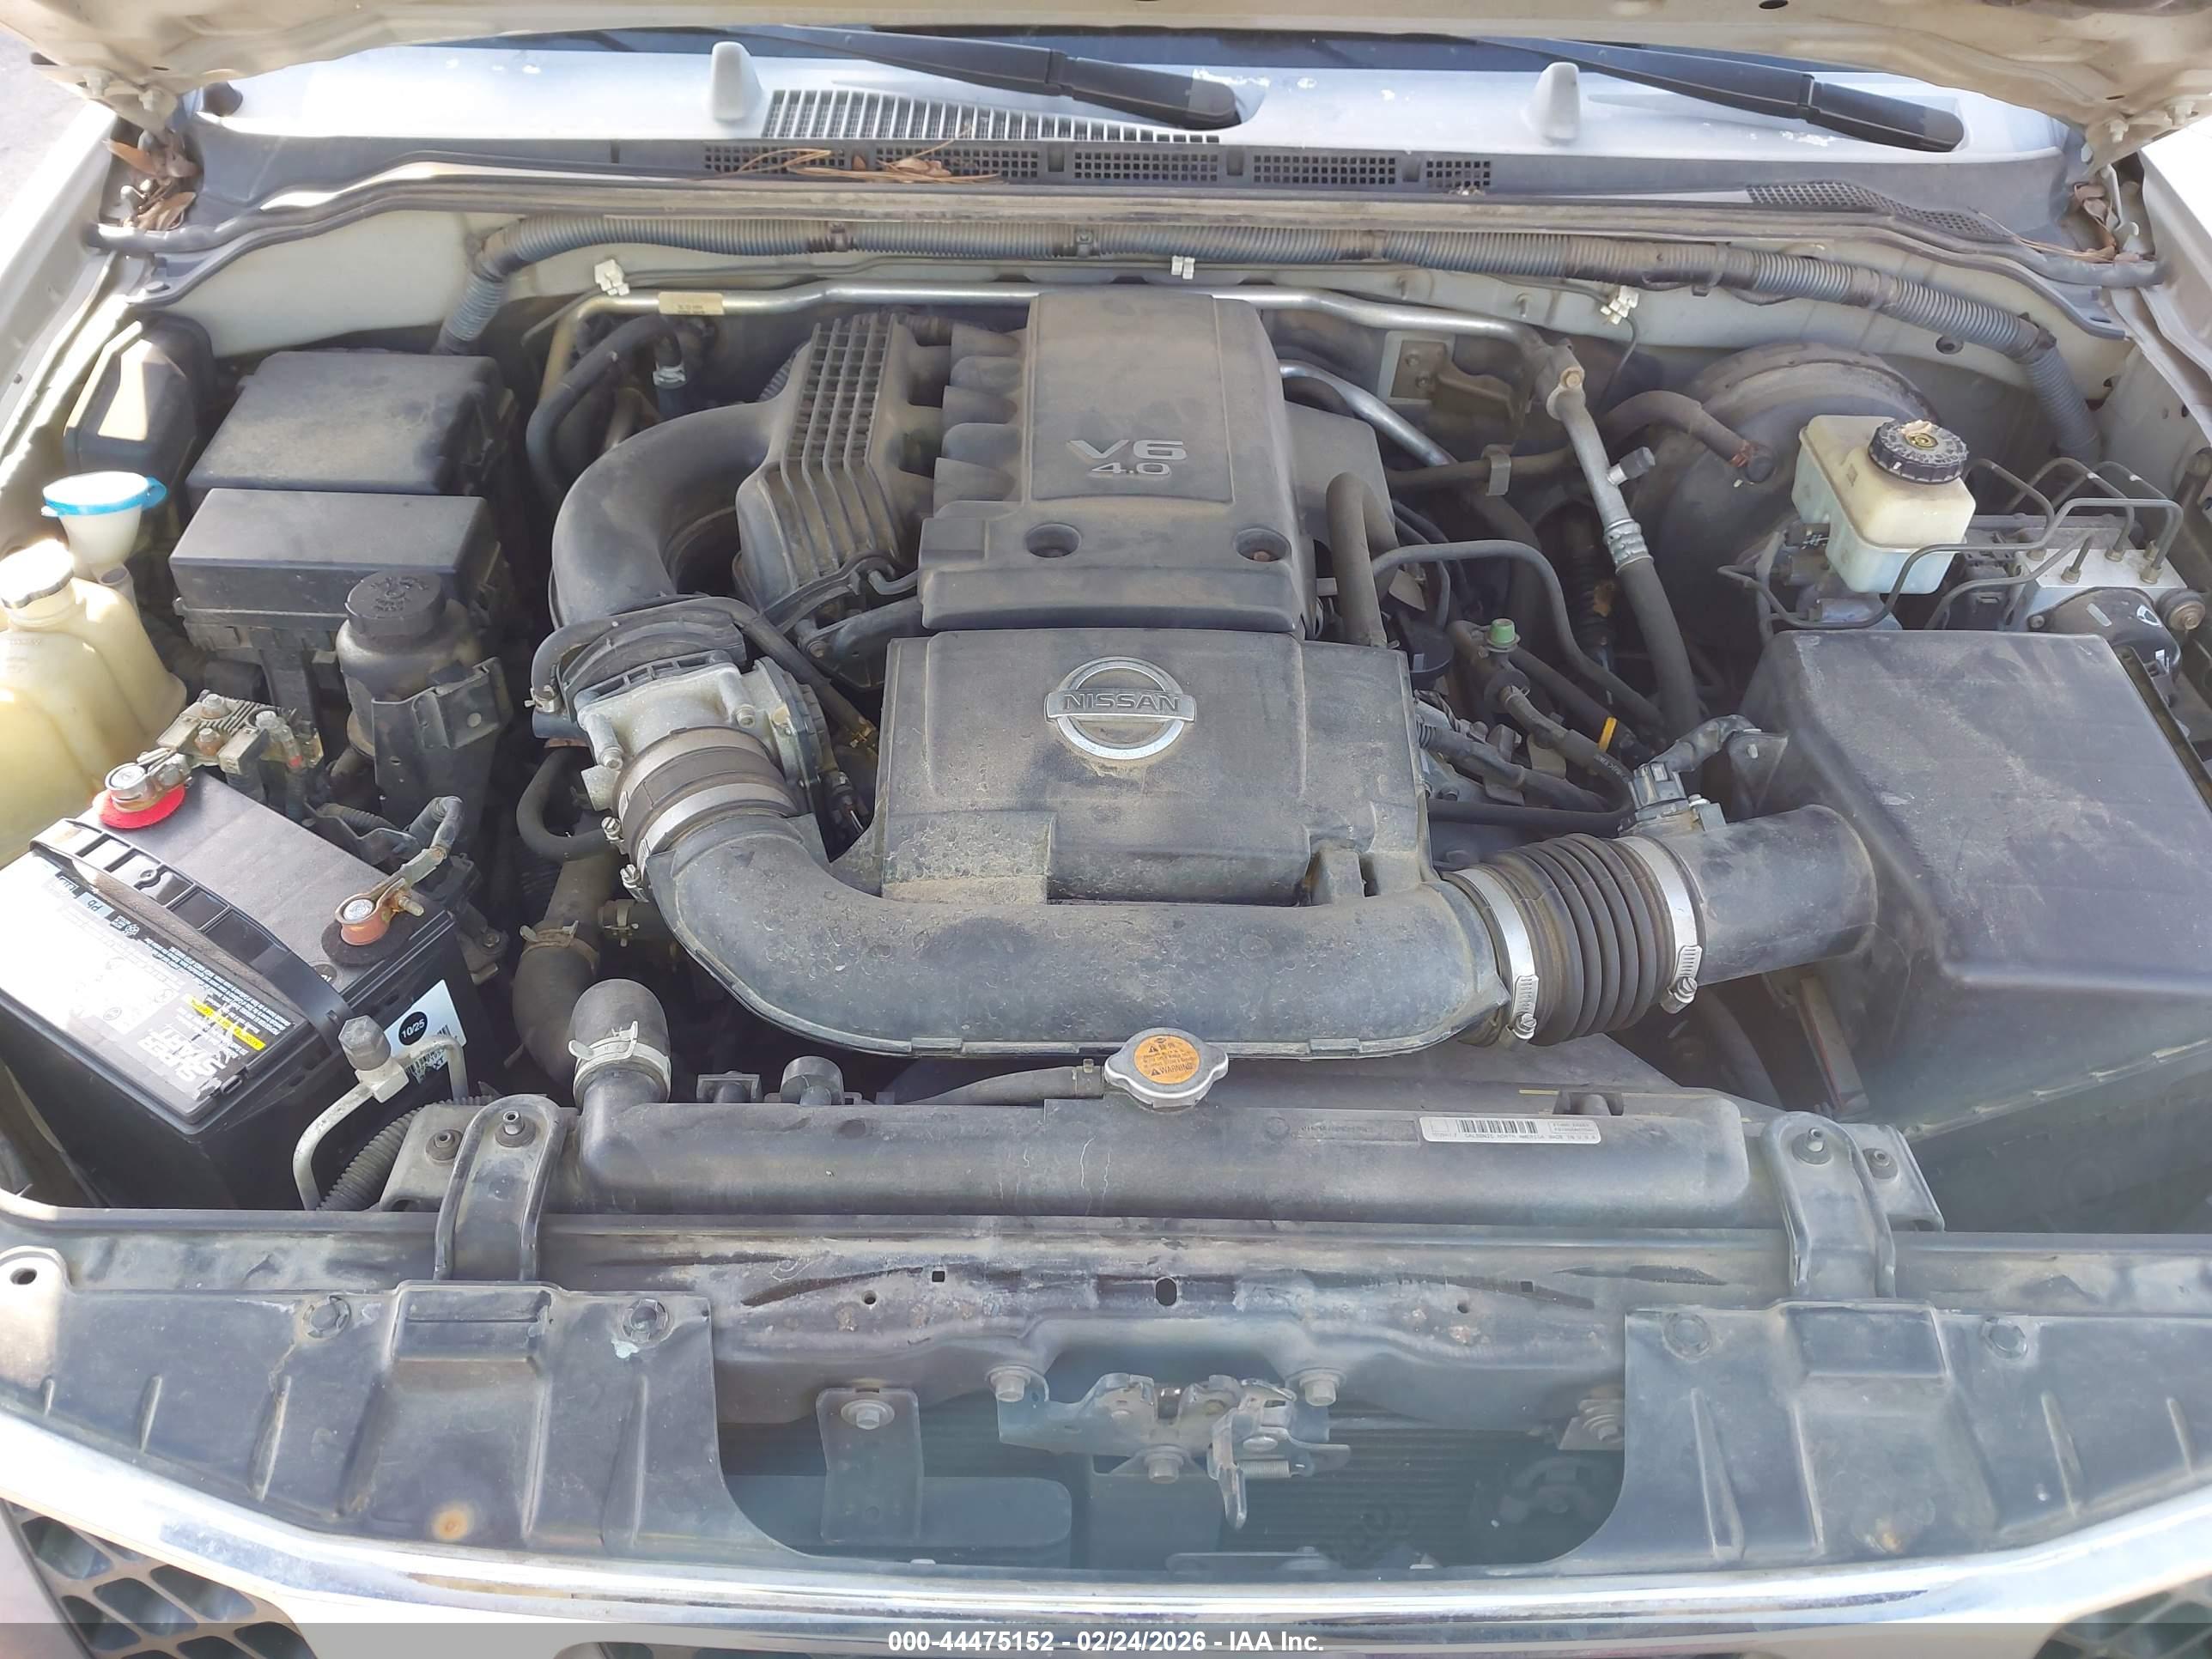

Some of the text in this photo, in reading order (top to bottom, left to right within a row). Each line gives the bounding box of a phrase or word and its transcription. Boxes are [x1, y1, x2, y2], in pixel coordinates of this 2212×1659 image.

[1069, 439, 1188, 460] V6
[1091, 462, 1171, 477] 4.0
[1063, 693, 1181, 711] NISSAN
[85, 897, 103, 912] Pb
[401, 1018, 425, 1038] 10/25
